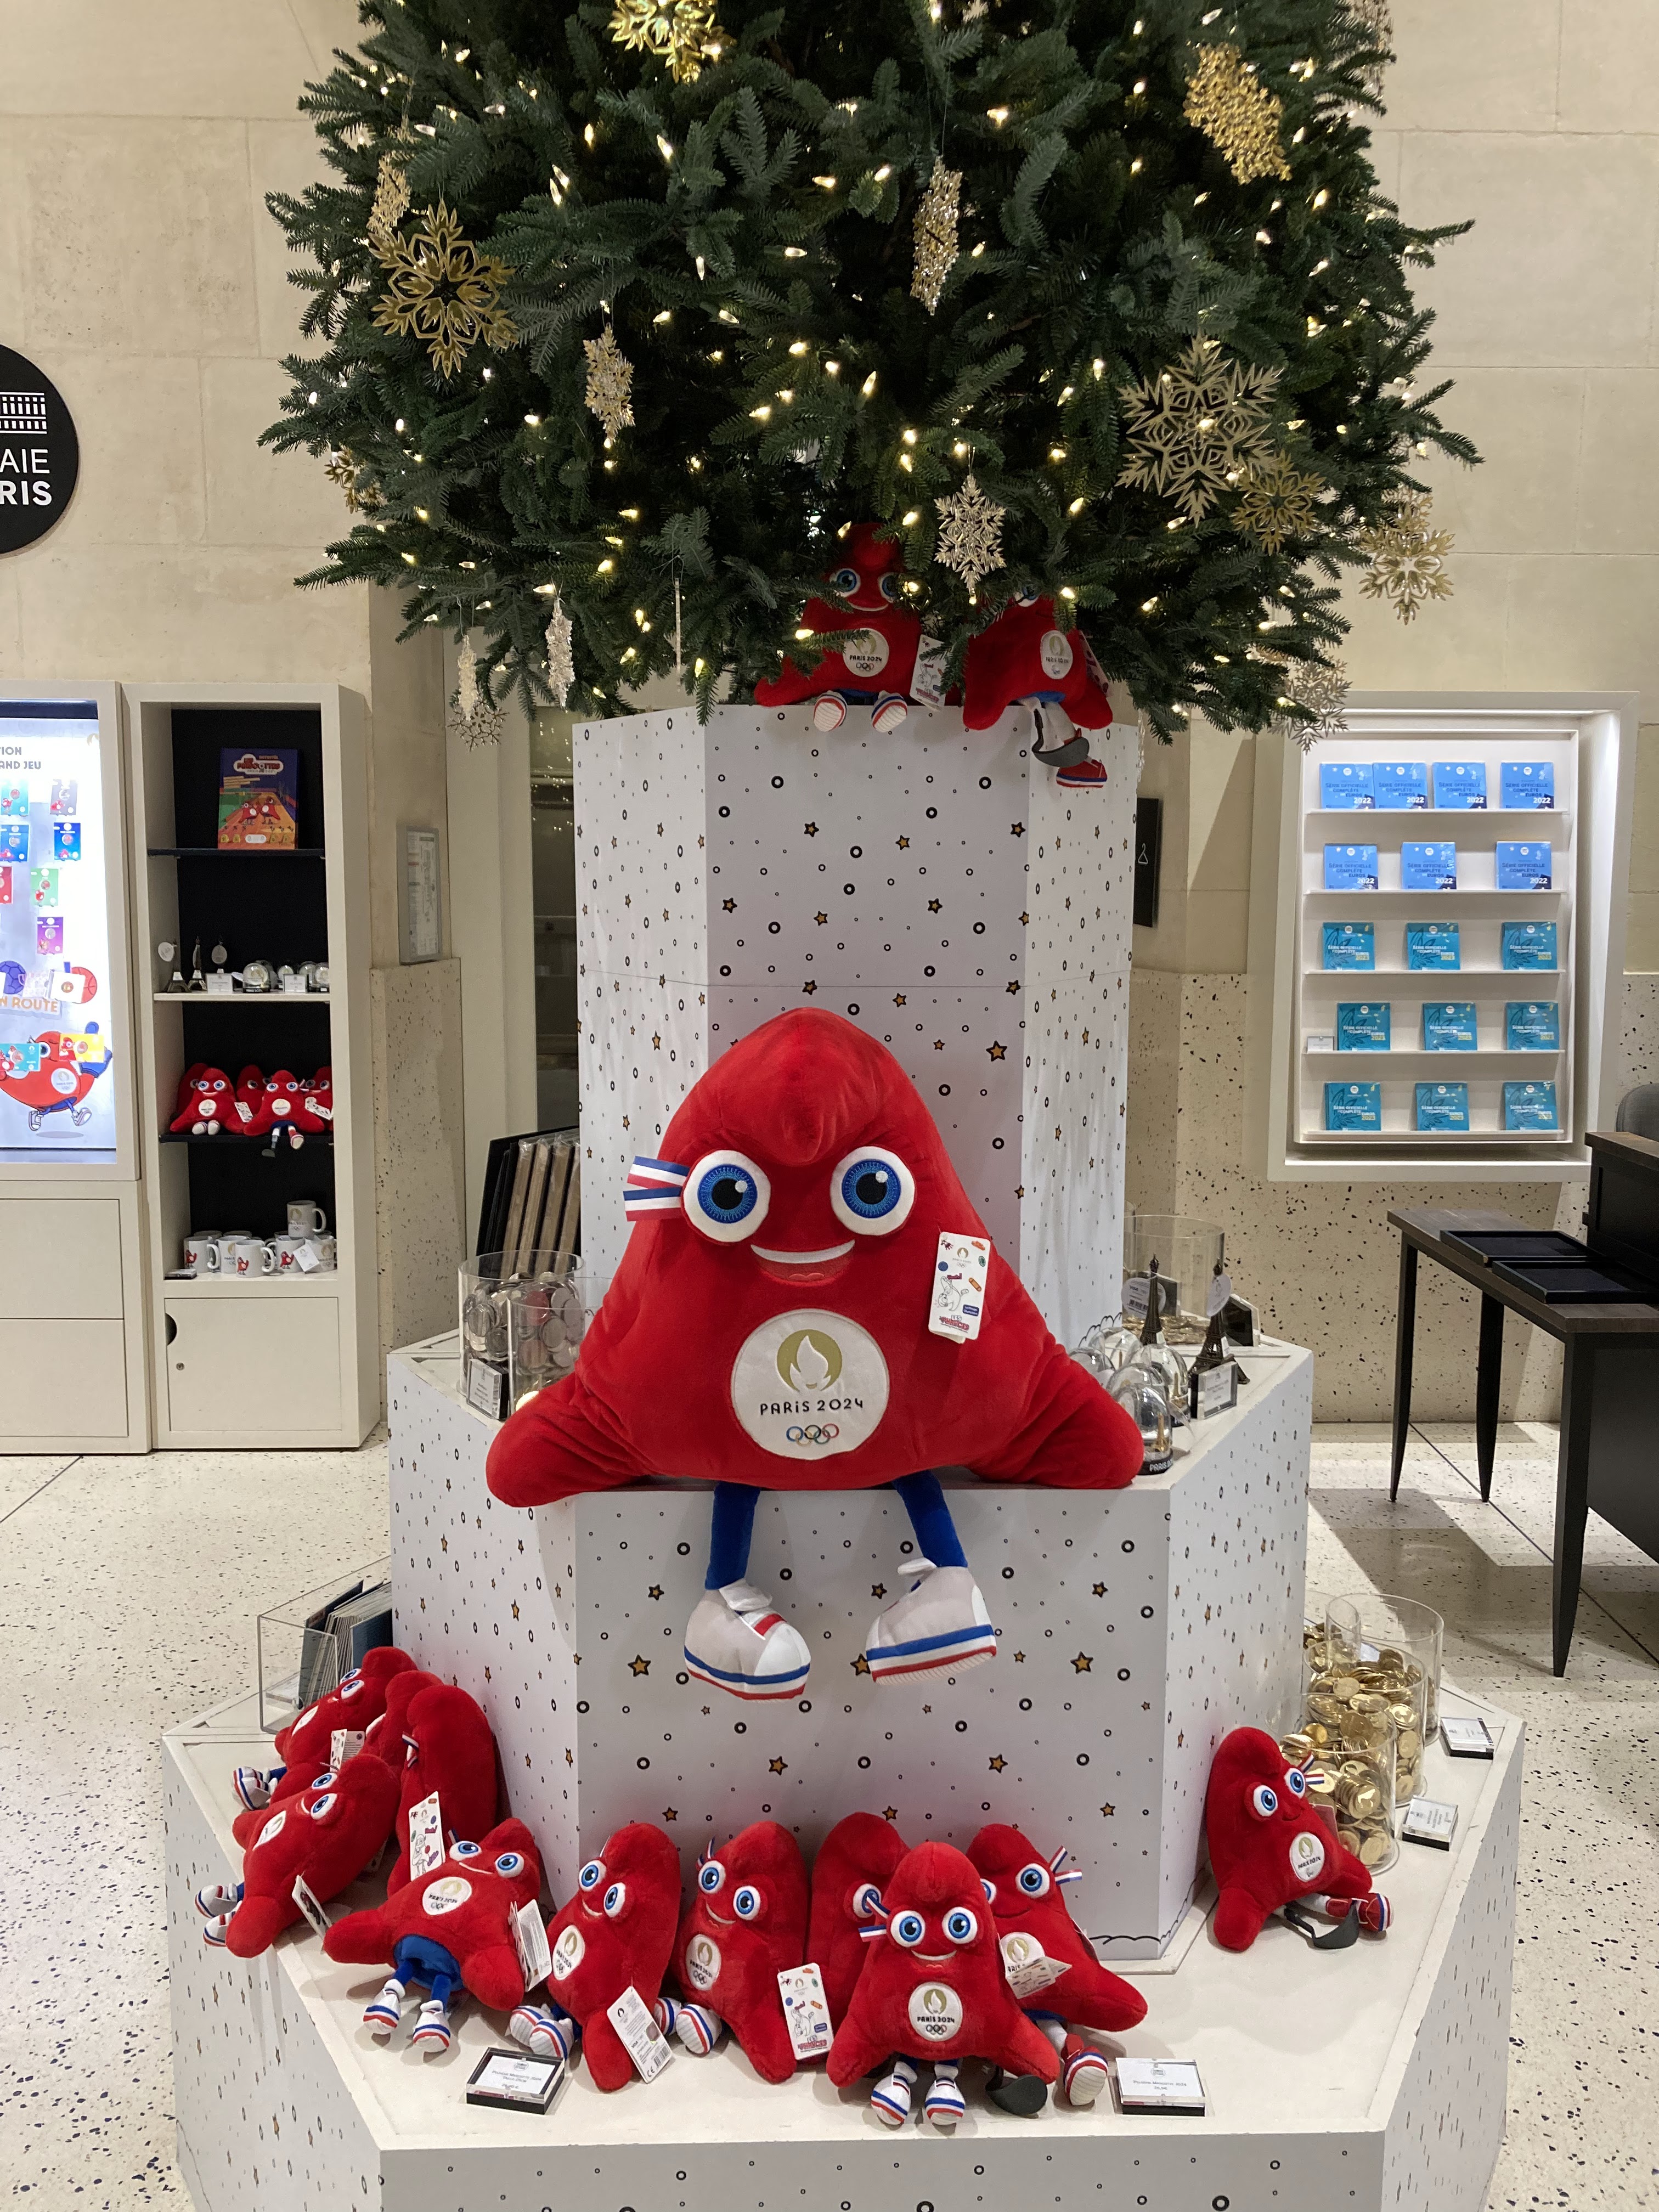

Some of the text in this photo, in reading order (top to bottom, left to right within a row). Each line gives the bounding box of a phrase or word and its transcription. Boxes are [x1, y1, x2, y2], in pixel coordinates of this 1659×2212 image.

[24, 761, 41, 769] JEU
[12, 997, 58, 1012] ROUTE
[817, 1398, 863, 1412] 2024
